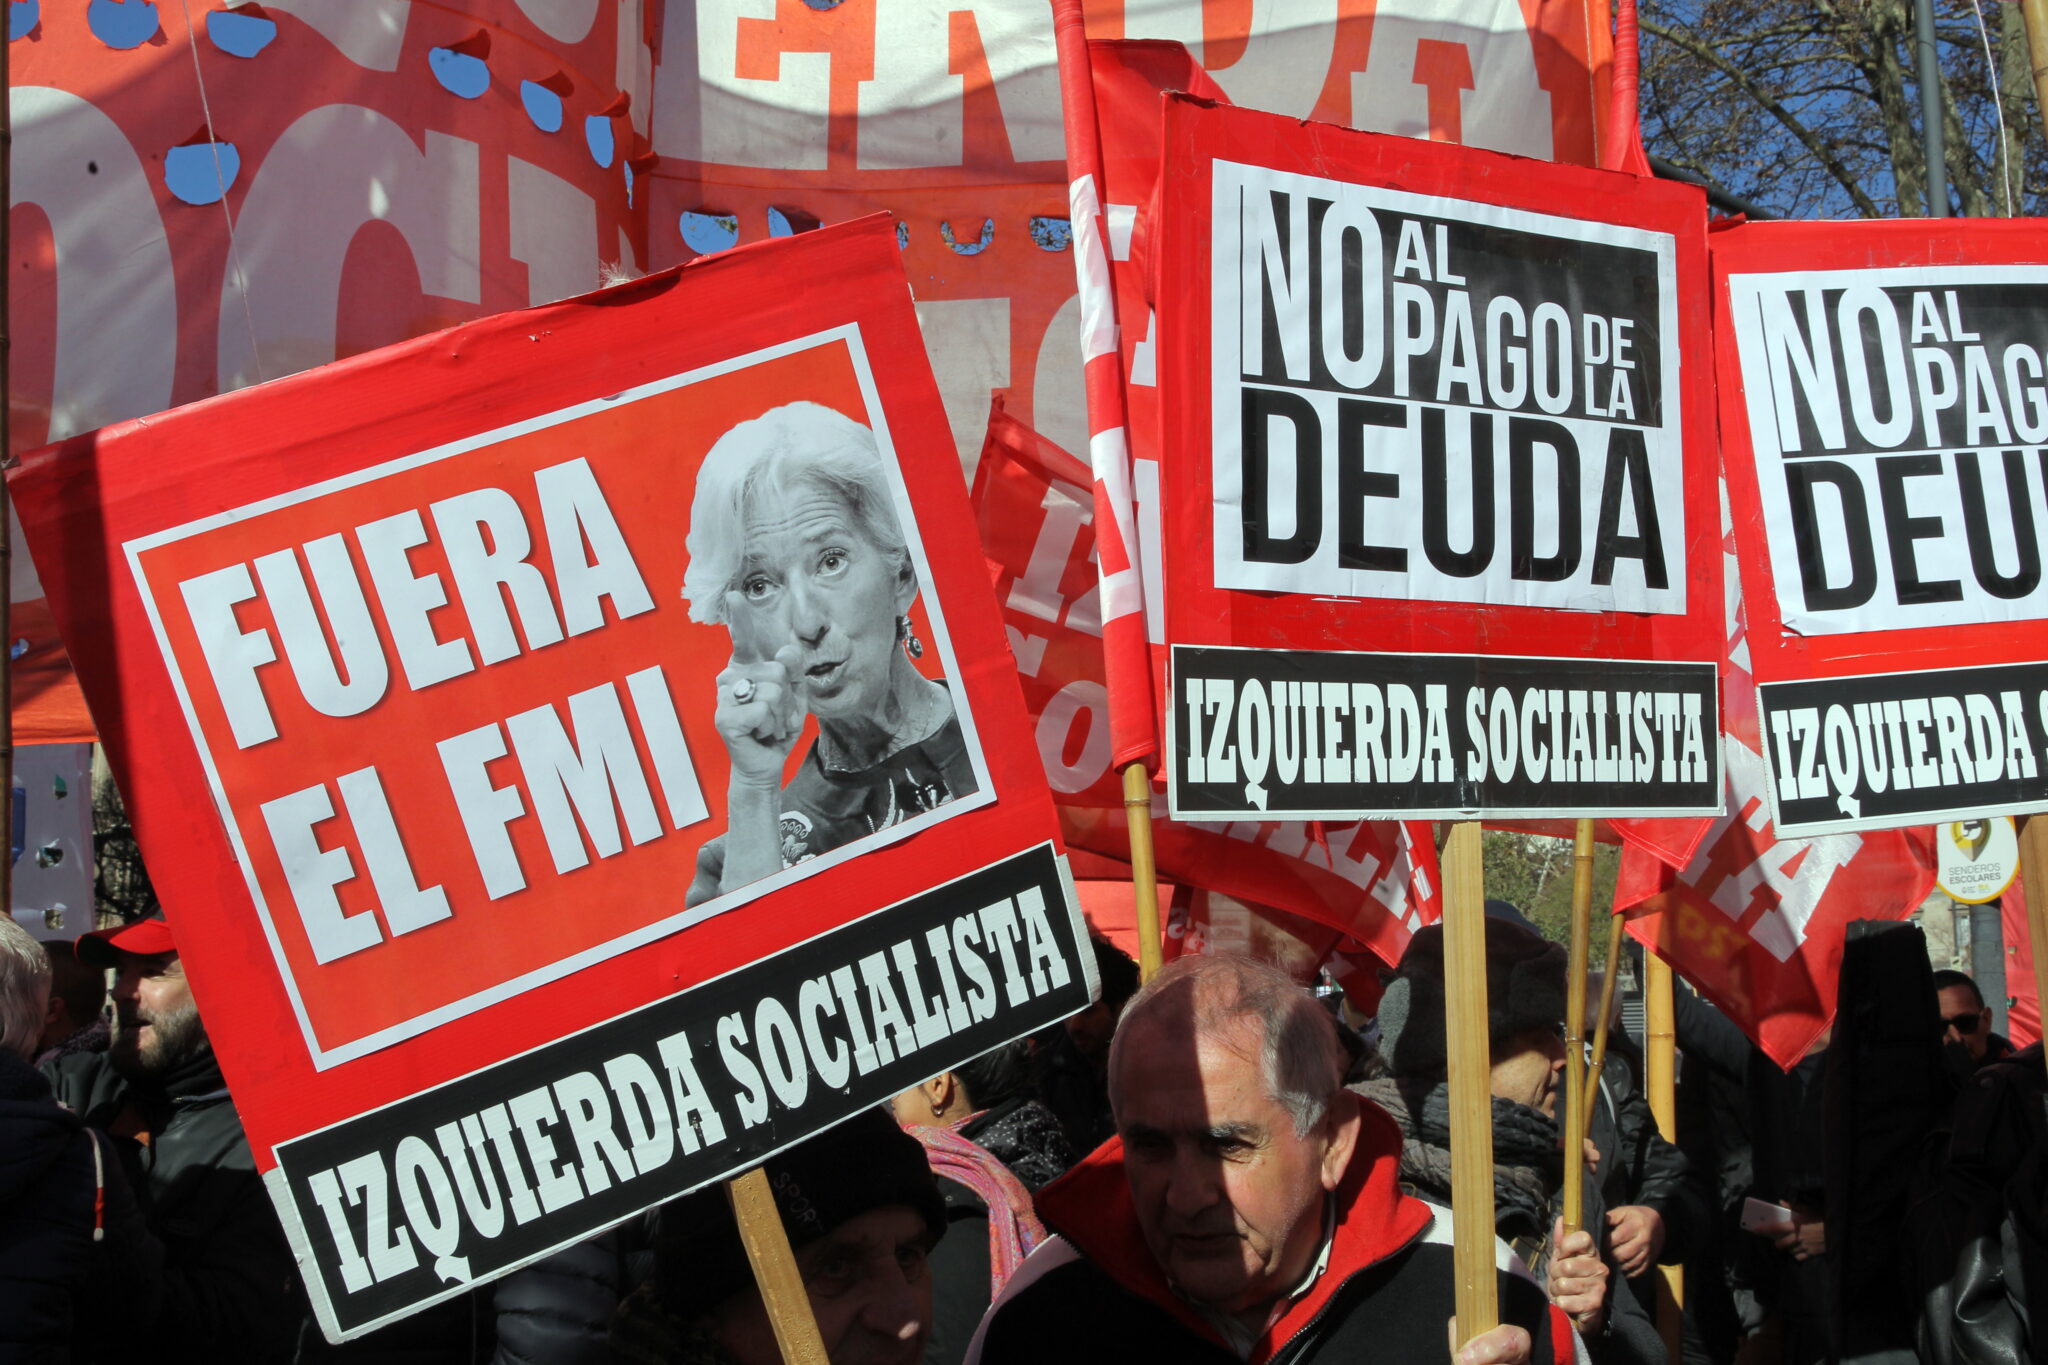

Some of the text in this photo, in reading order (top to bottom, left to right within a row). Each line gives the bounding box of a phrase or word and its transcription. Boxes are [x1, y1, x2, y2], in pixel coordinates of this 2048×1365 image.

[1241, 188, 1385, 391] NO
[1393, 220, 1466, 287] AL
[1393, 289, 1636, 414] PAGO DE
[1584, 364, 1636, 420] LA
[1760, 287, 1981, 453] NO AL
[1912, 343, 2048, 447] PAG
[1242, 390, 1669, 590] DEUDA
[1784, 449, 2048, 612] DEU
[178, 456, 655, 749] FUERA
[260, 664, 710, 966] EL FMI
[1186, 678, 1455, 810] IZQUIERDA
[1466, 687, 1708, 785] SOCIALISTA
[1771, 690, 2037, 818] IZQUIERDA
[1948, 862, 2001, 876] SENDEROS
[1949, 872, 2001, 885] ESCOLARES
[307, 885, 1073, 1292] IZQUIERDA SOCIALISTA
